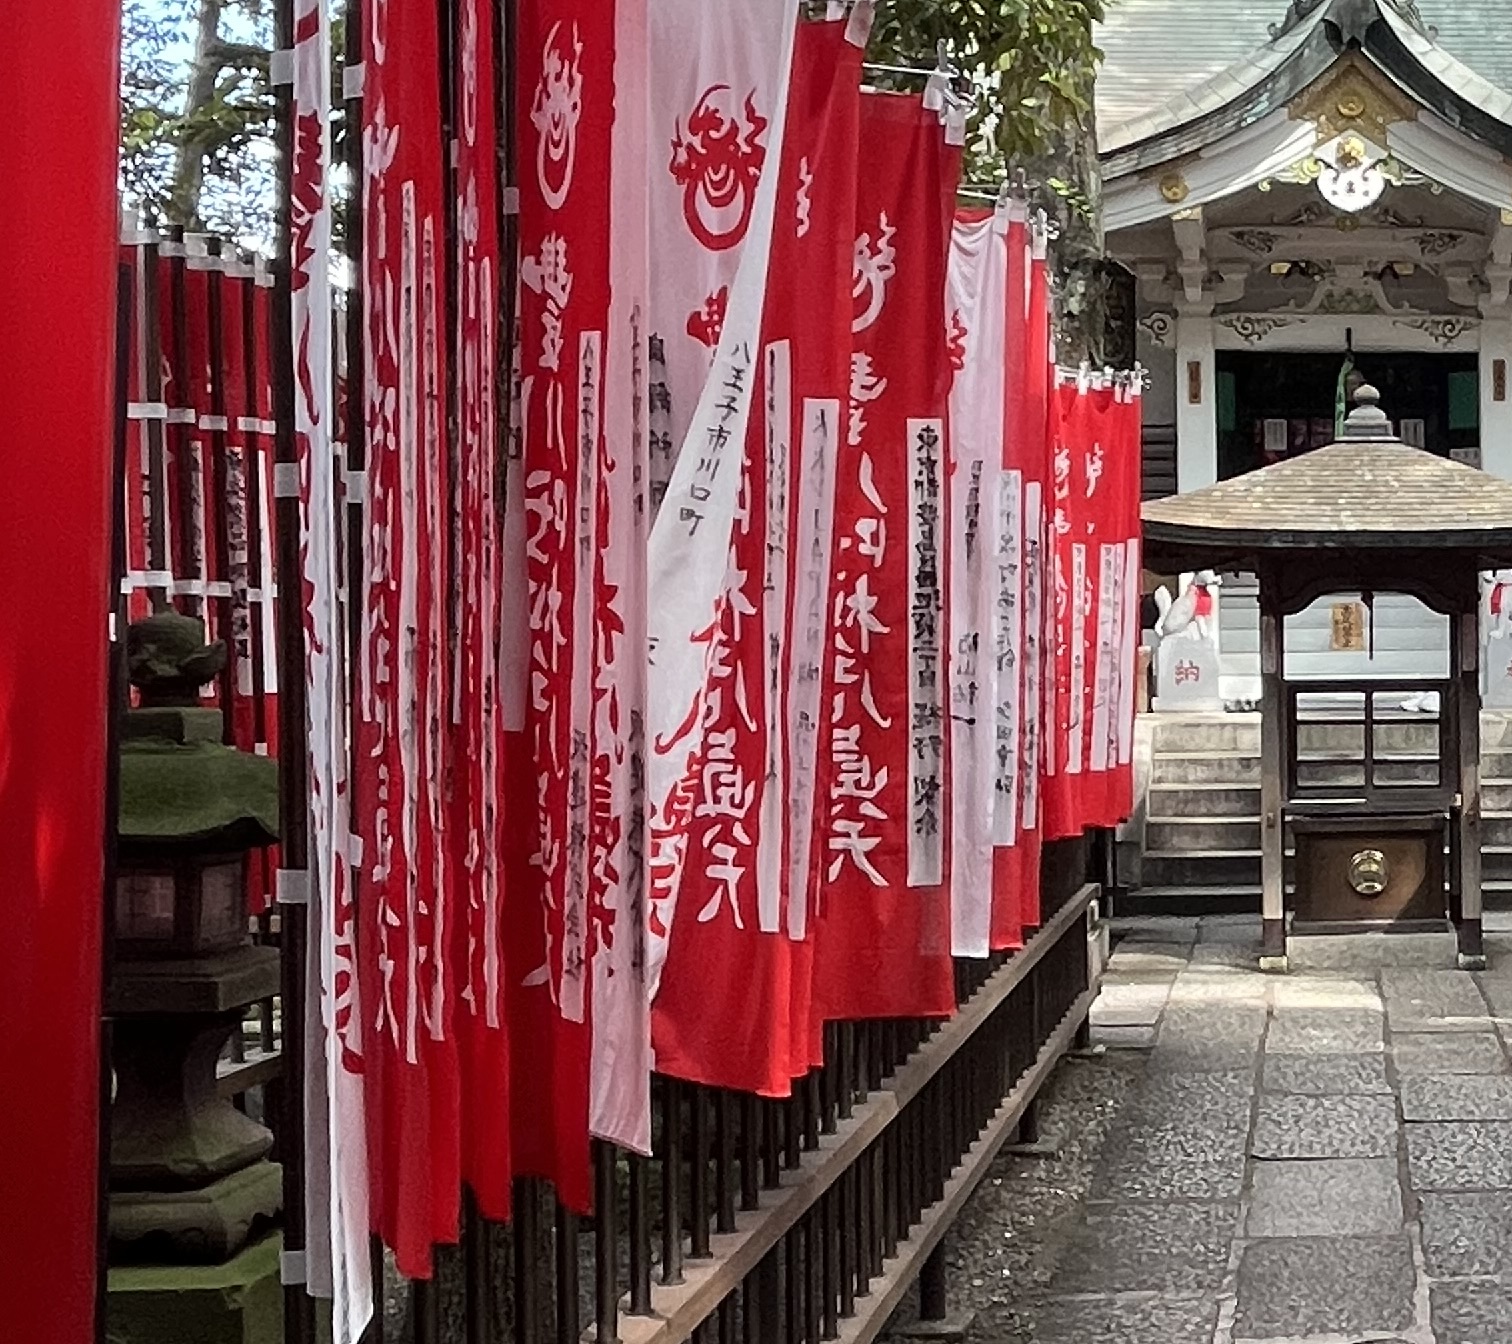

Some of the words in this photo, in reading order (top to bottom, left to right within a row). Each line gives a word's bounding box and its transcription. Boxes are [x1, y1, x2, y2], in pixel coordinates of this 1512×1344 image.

[680, 341, 751, 536] 八王子市川口町
